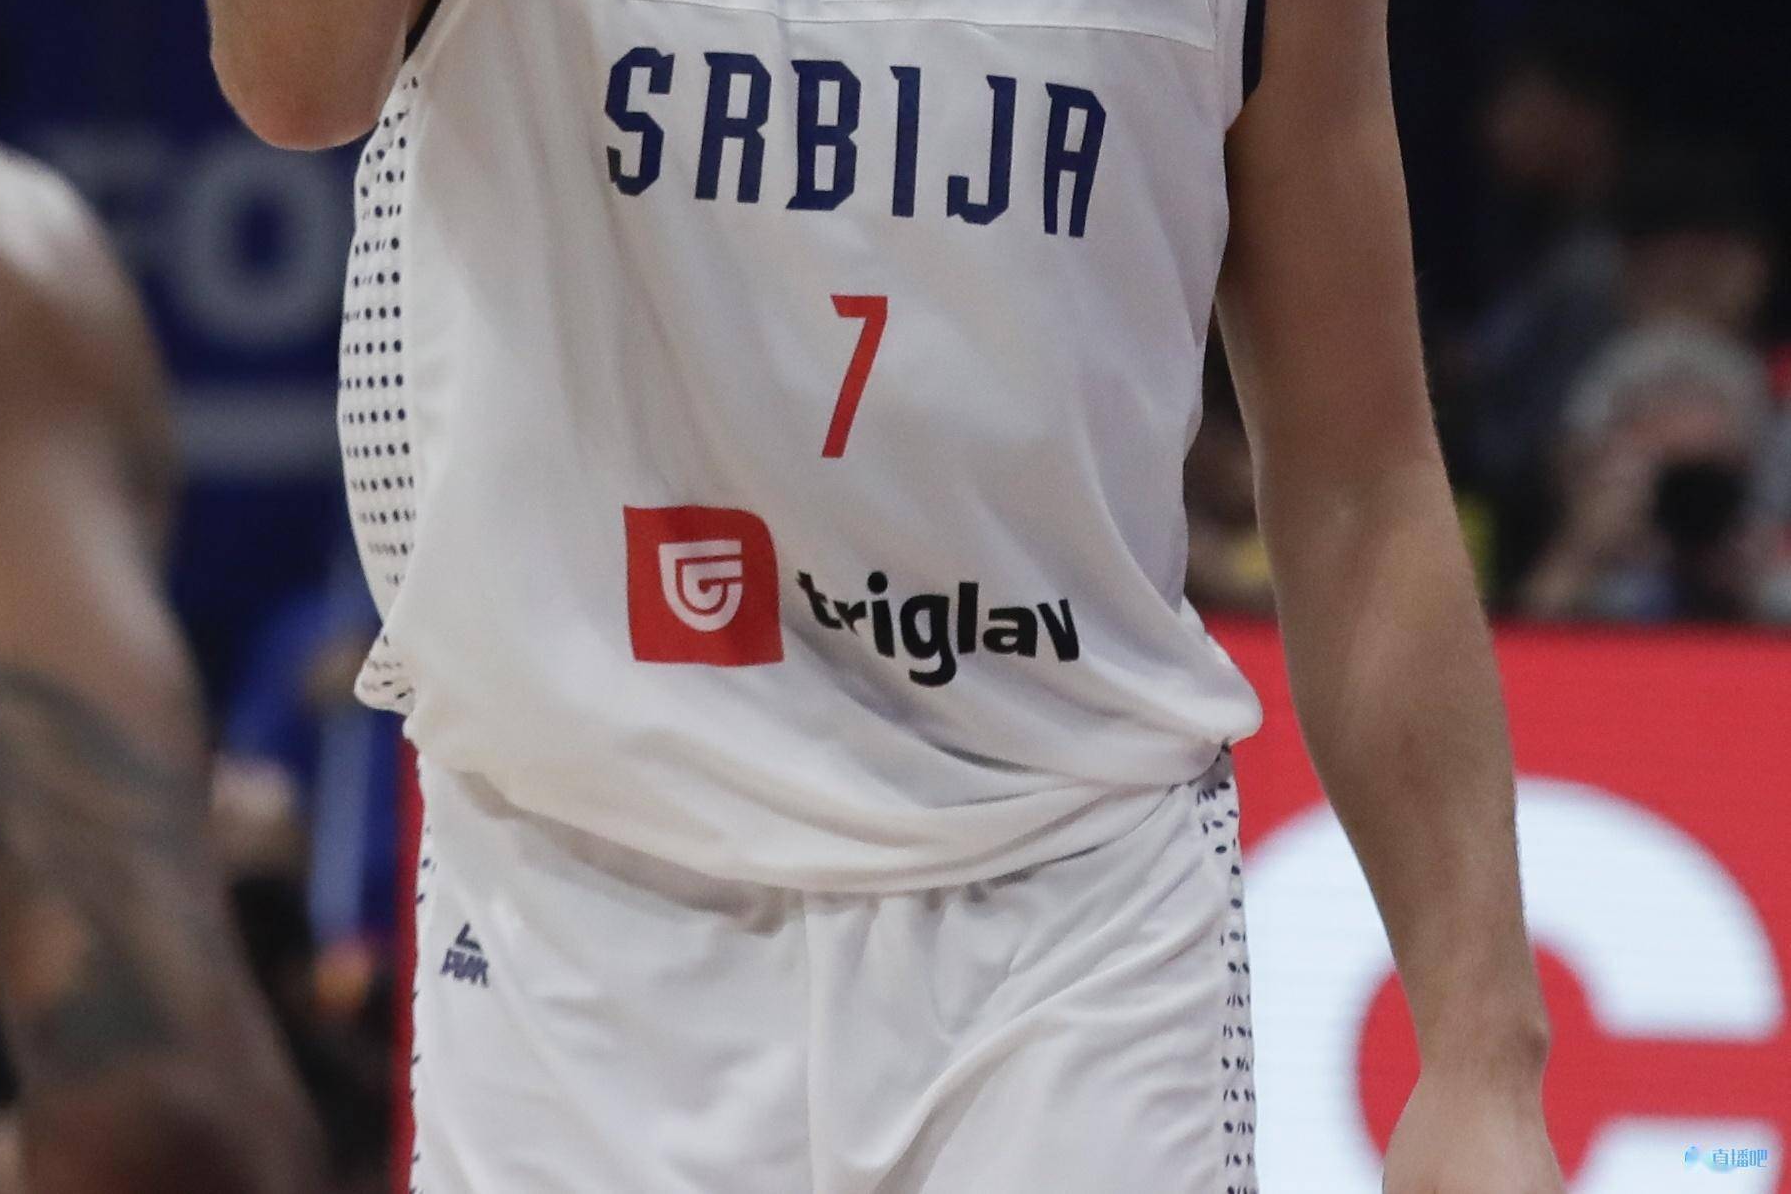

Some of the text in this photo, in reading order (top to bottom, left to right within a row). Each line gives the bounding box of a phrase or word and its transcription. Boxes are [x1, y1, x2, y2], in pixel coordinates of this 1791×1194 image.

[605, 47, 1107, 238] SRBIJA
[821, 294, 888, 458] 7
[797, 569, 1080, 686] triglav
